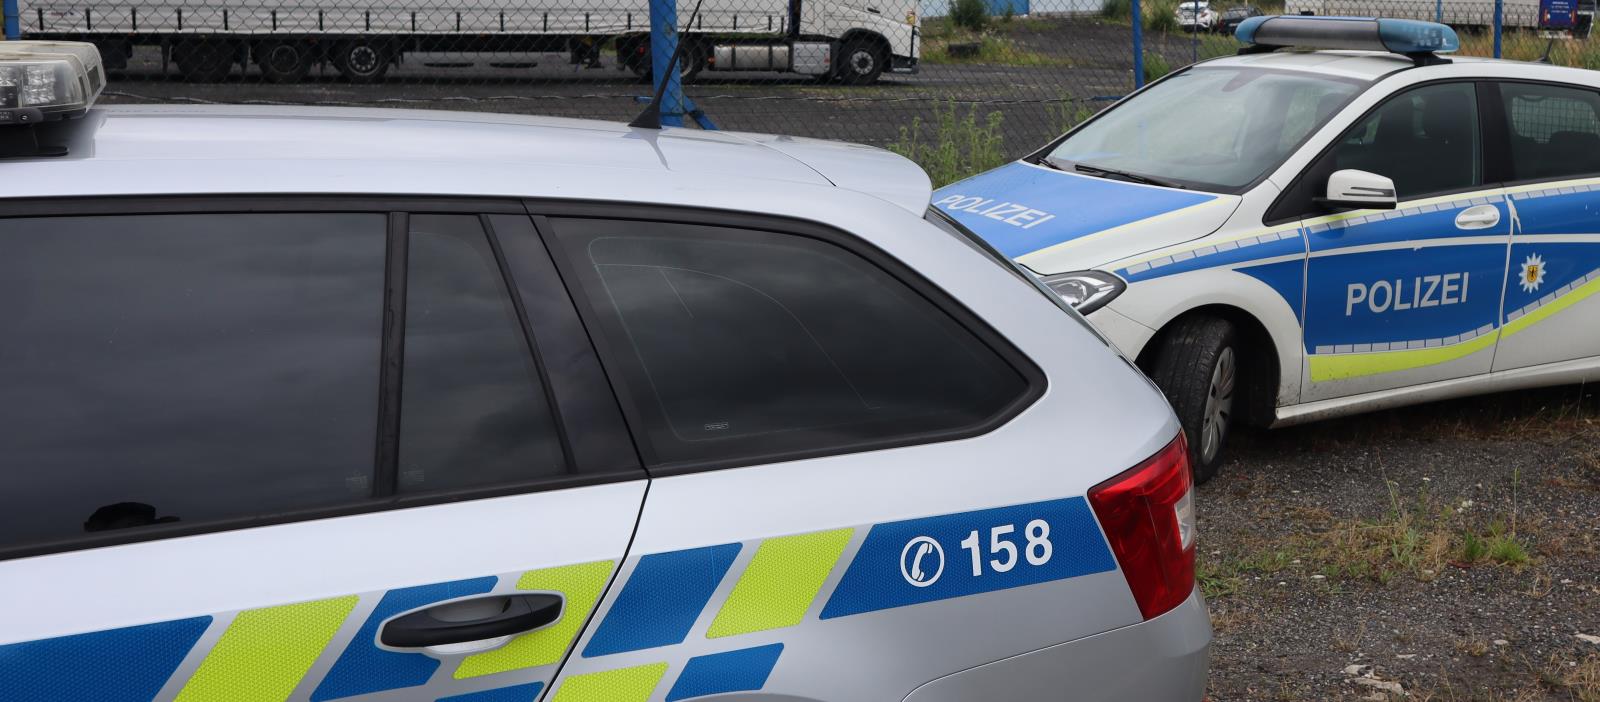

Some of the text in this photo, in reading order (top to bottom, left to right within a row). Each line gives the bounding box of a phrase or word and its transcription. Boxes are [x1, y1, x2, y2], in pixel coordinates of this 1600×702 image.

[933, 194, 1056, 229] POLIZEI
[1345, 271, 1470, 316] POLIZEI
[960, 518, 1053, 577] 158
